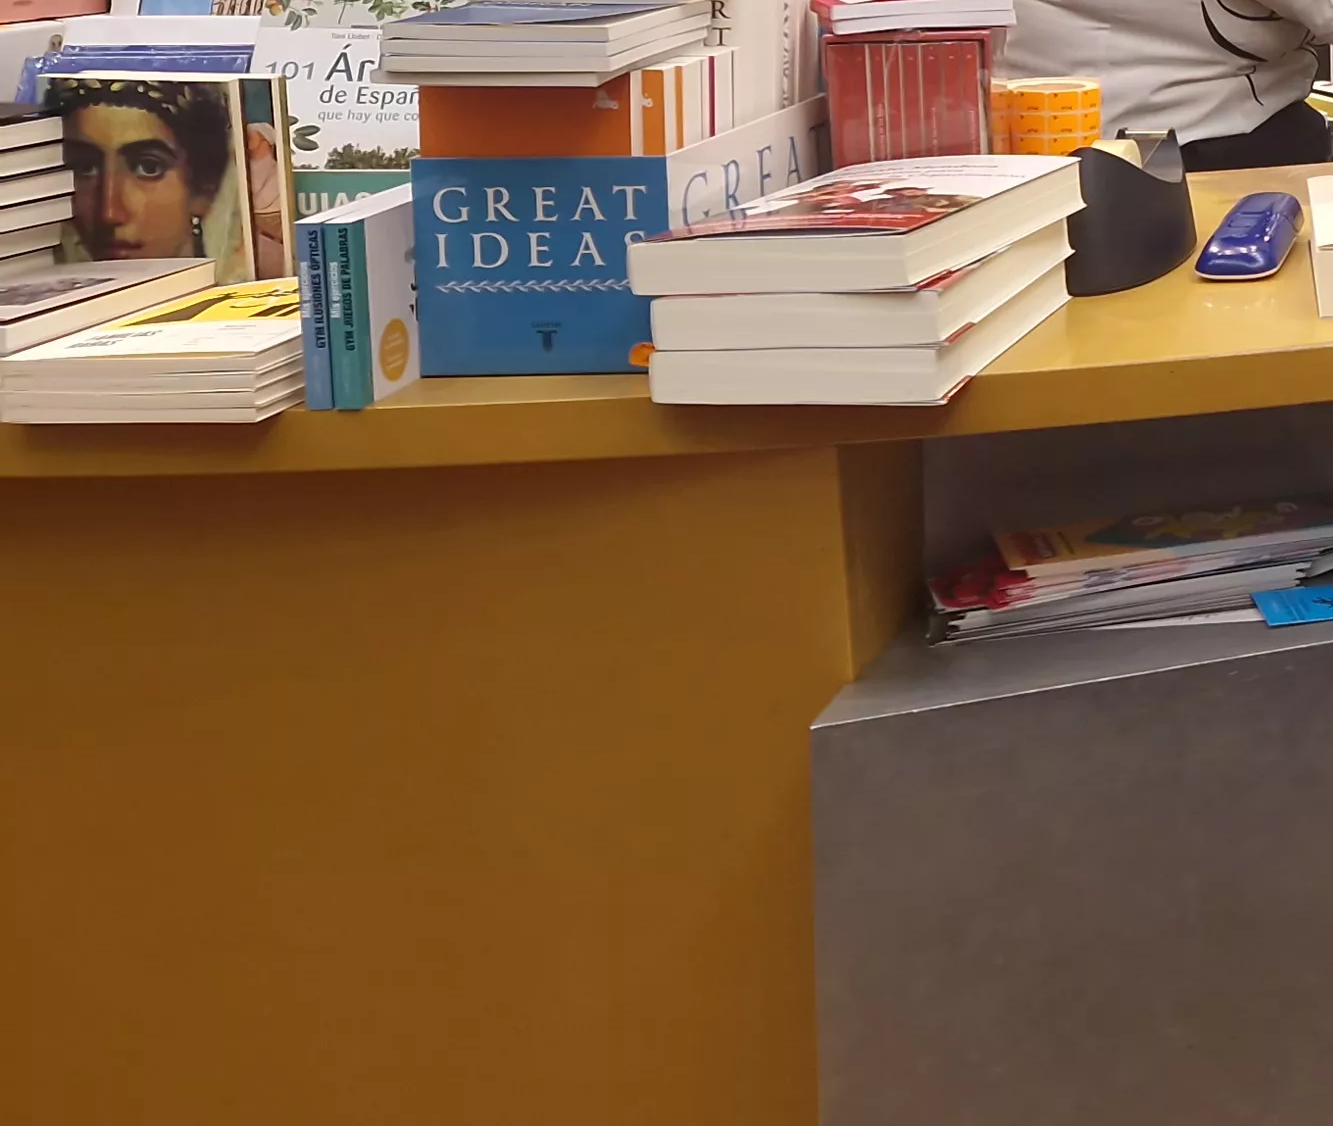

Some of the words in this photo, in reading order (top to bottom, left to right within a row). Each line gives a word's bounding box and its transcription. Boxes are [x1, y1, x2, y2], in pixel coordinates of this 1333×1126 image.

[264, 60, 315, 82] 101
[324, 43, 376, 82] Ár
[319, 85, 347, 105] de
[318, 110, 343, 123] que
[347, 110, 372, 123] hay
[375, 110, 399, 123] que
[403, 112, 419, 121] co
[432, 185, 647, 223] GREAT
[308, 230, 320, 271] ÓPTICAS
[337, 228, 350, 274] PALABRAS
[340, 277, 352, 291] DE
[311, 274, 324, 324] ILUSIONES
[330, 303, 341, 318] Mis
[341, 294, 354, 327] JUEGOS
[315, 326, 326, 349] GYM
[344, 330, 356, 351] GYM
